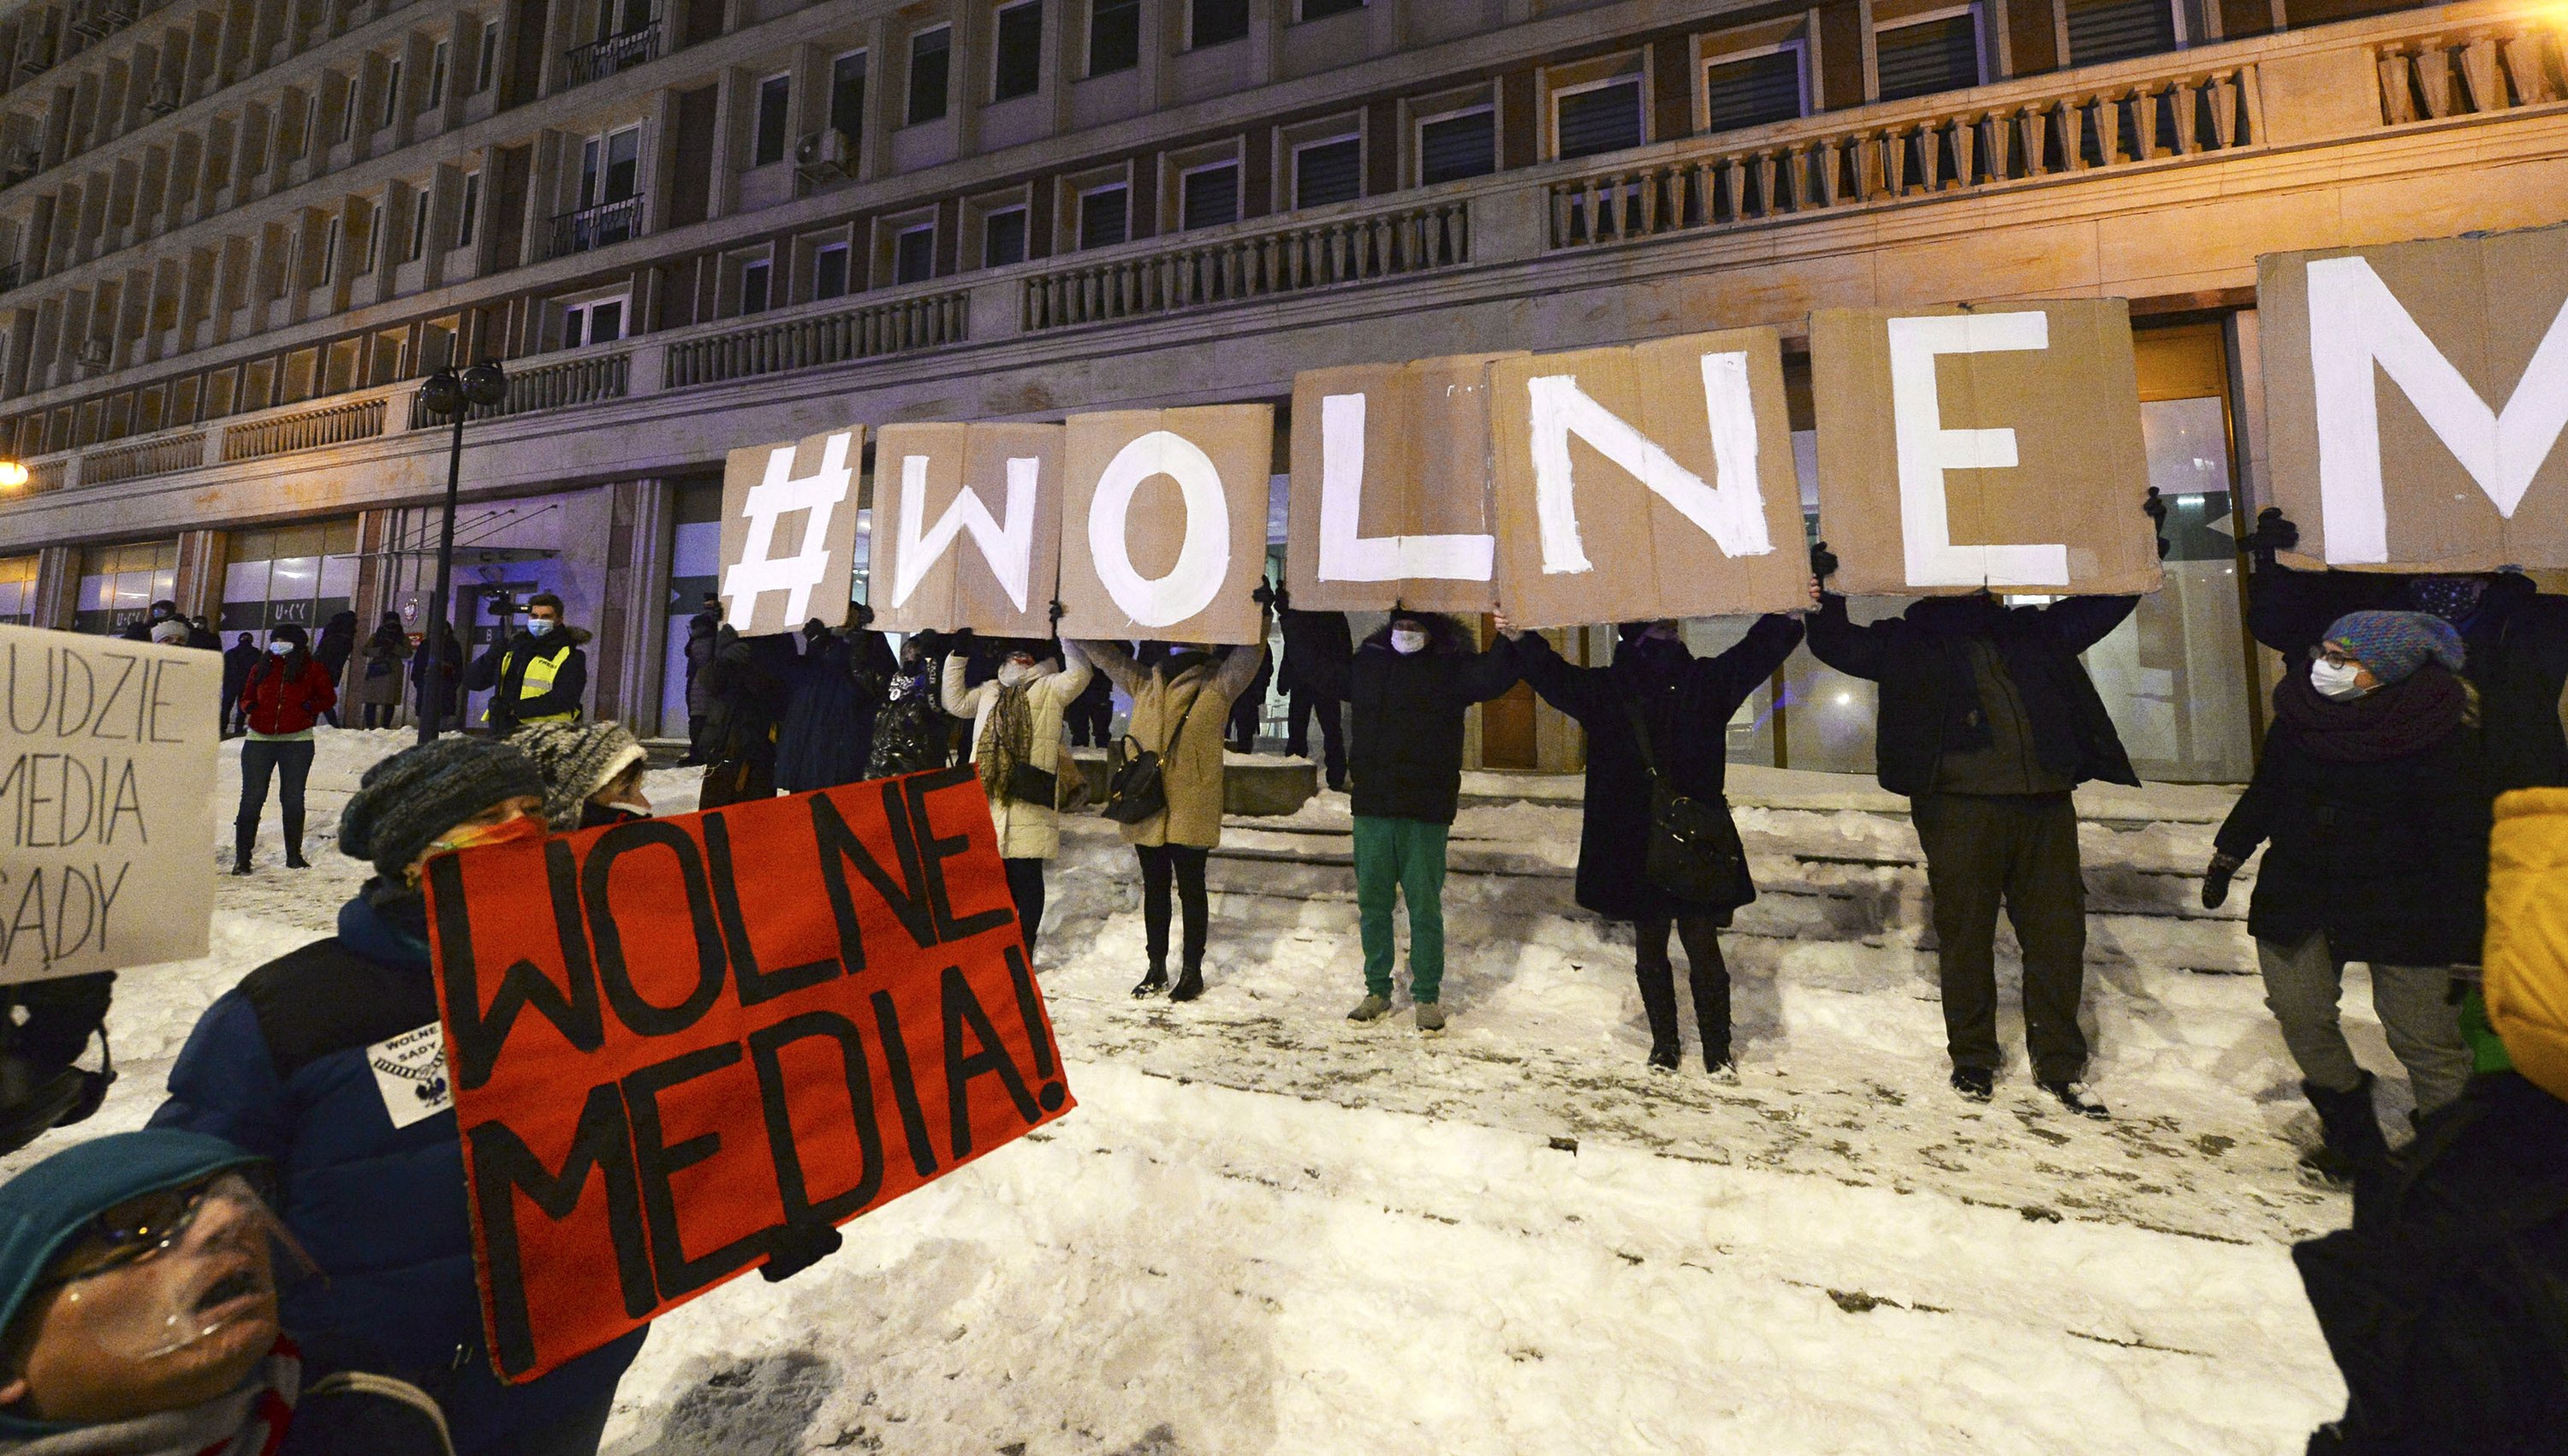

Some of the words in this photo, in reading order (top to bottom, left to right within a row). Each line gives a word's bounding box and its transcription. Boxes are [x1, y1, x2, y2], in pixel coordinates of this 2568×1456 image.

[722, 311, 2070, 630] #WOLNE
[0, 861, 130, 972] ĄDY
[385, 1026, 438, 1051] WOLNE
[428, 764, 1015, 1091] WOLNE
[467, 943, 1067, 1371] MEDIA!
